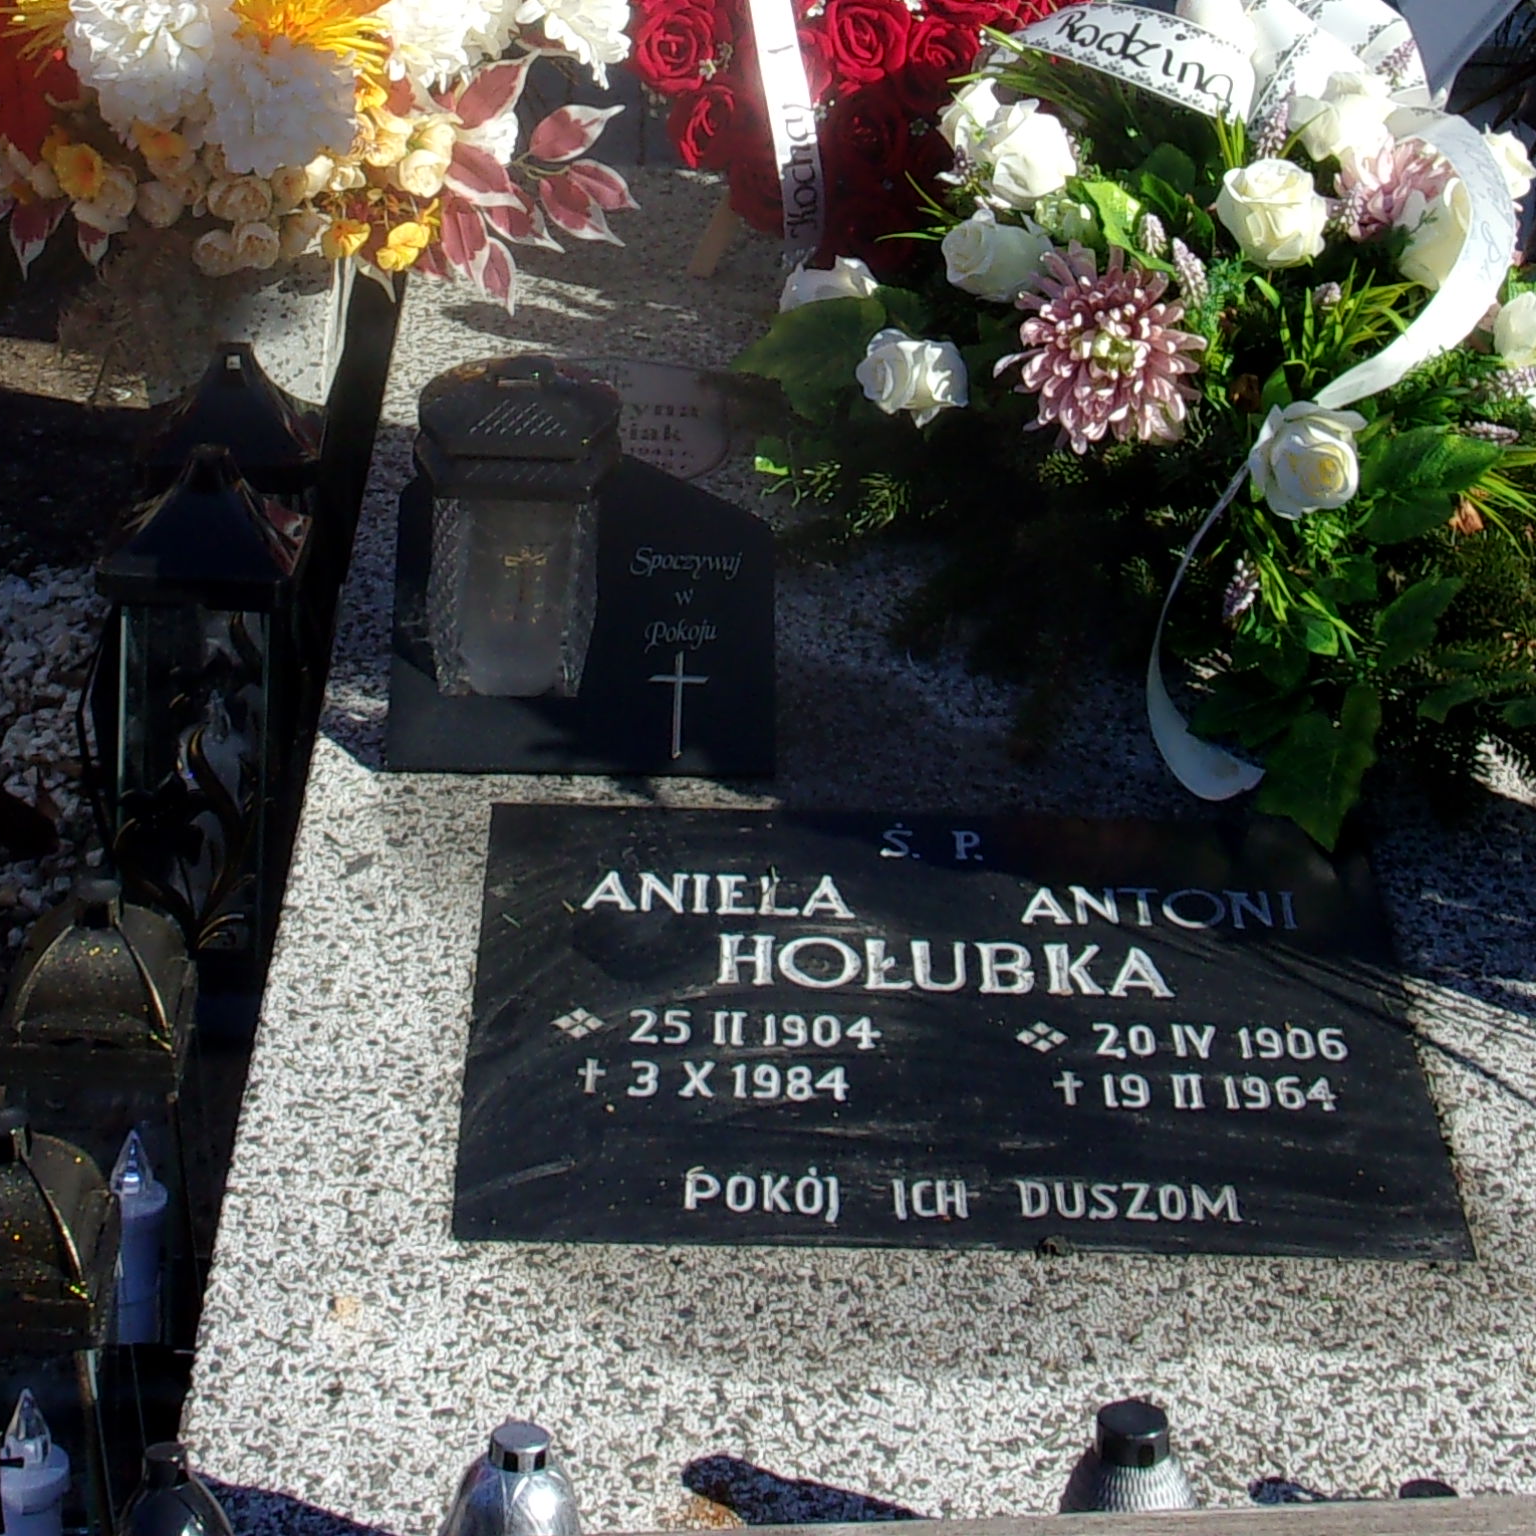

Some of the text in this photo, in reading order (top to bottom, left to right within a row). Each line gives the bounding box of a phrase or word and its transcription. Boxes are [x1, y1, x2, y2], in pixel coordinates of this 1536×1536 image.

[630, 547, 743, 580] Spoczywaj
[675, 589, 694, 605] w
[644, 619, 717, 653] Pokoju
[952, 830, 983, 861] P.
[1021, 885, 1298, 930] ANTONI
[717, 933, 1176, 999] HOŁUBKA
[629, 1010, 882, 1050] 25 II 1904
[1092, 1023, 1348, 1061] 20 IV 1906
[627, 1061, 850, 1102] 3 X 1984
[1102, 1073, 1337, 1113] 19 II 1964
[683, 1166, 1242, 1225] POKÓJ ICH DUSZOM
